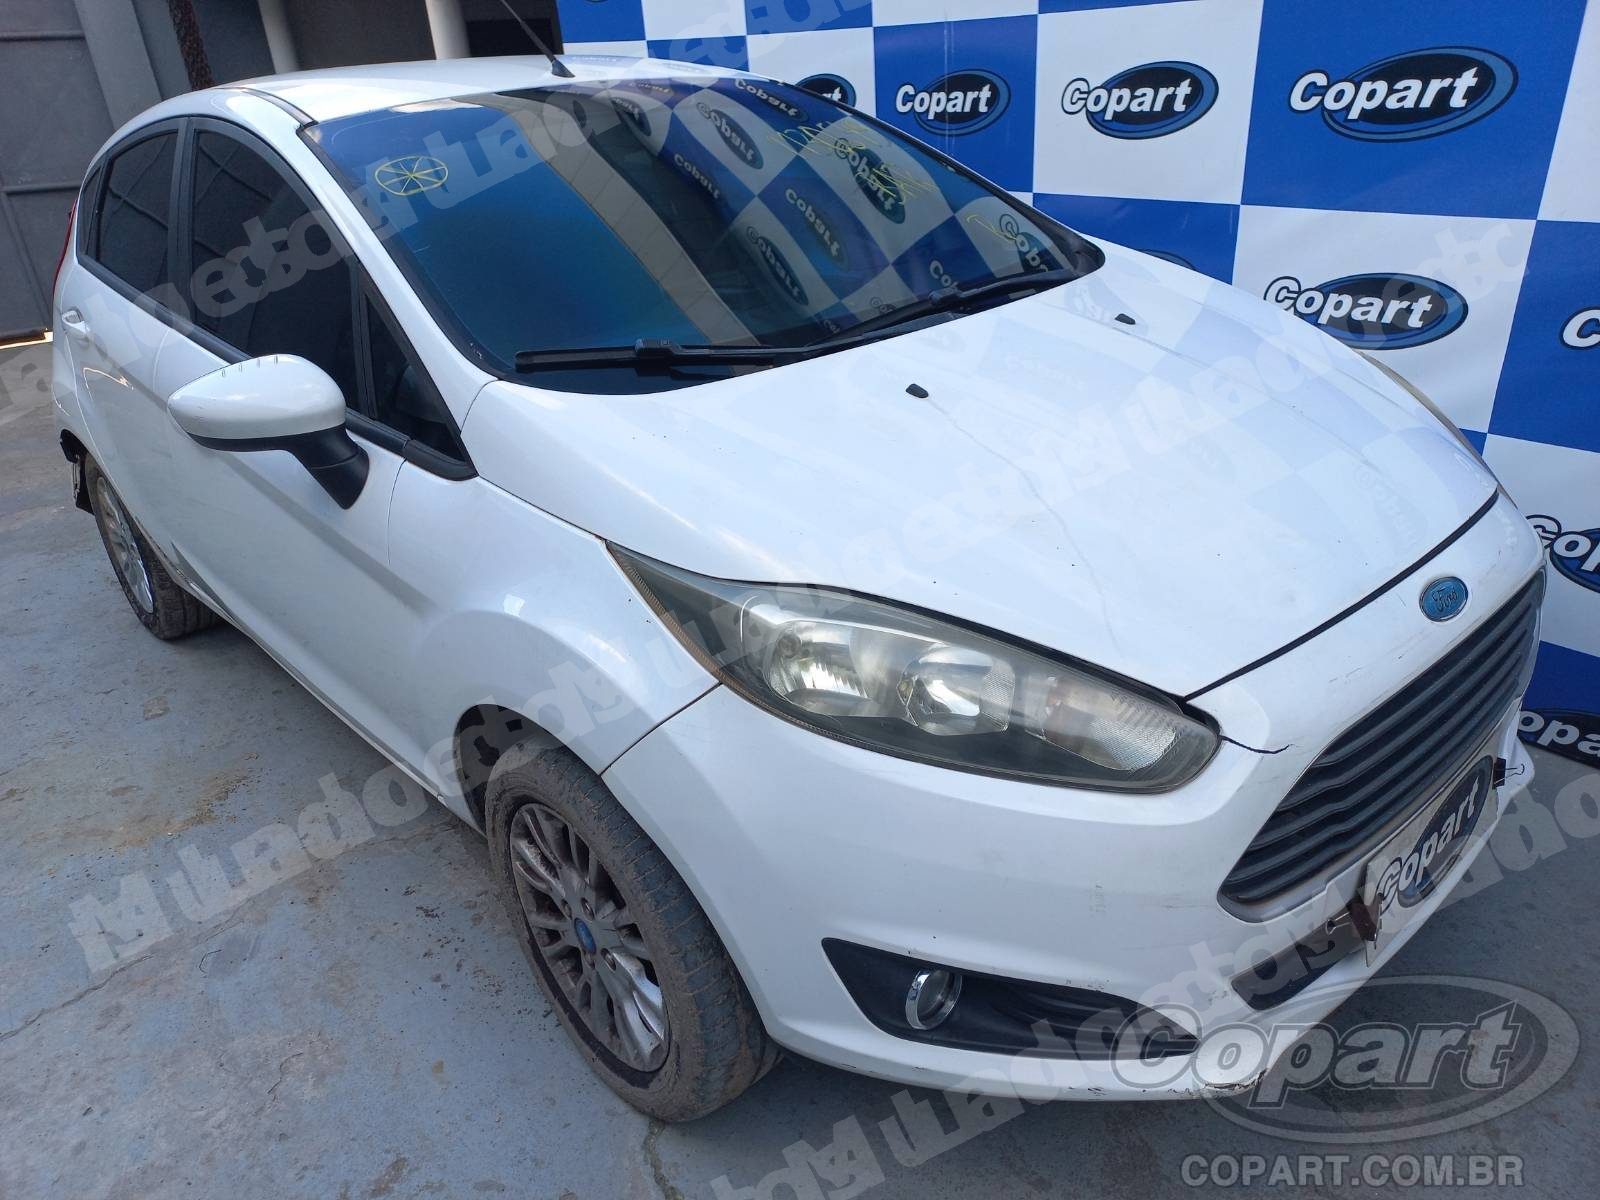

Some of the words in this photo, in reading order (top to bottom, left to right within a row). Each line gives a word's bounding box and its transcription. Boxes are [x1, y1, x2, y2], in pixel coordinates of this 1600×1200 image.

[895, 83, 992, 121] Copart
[1062, 77, 1193, 121] Copart
[1289, 66, 1480, 121] Copart
[1264, 276, 1432, 329] Copart
[1376, 776, 1480, 914] Copart
